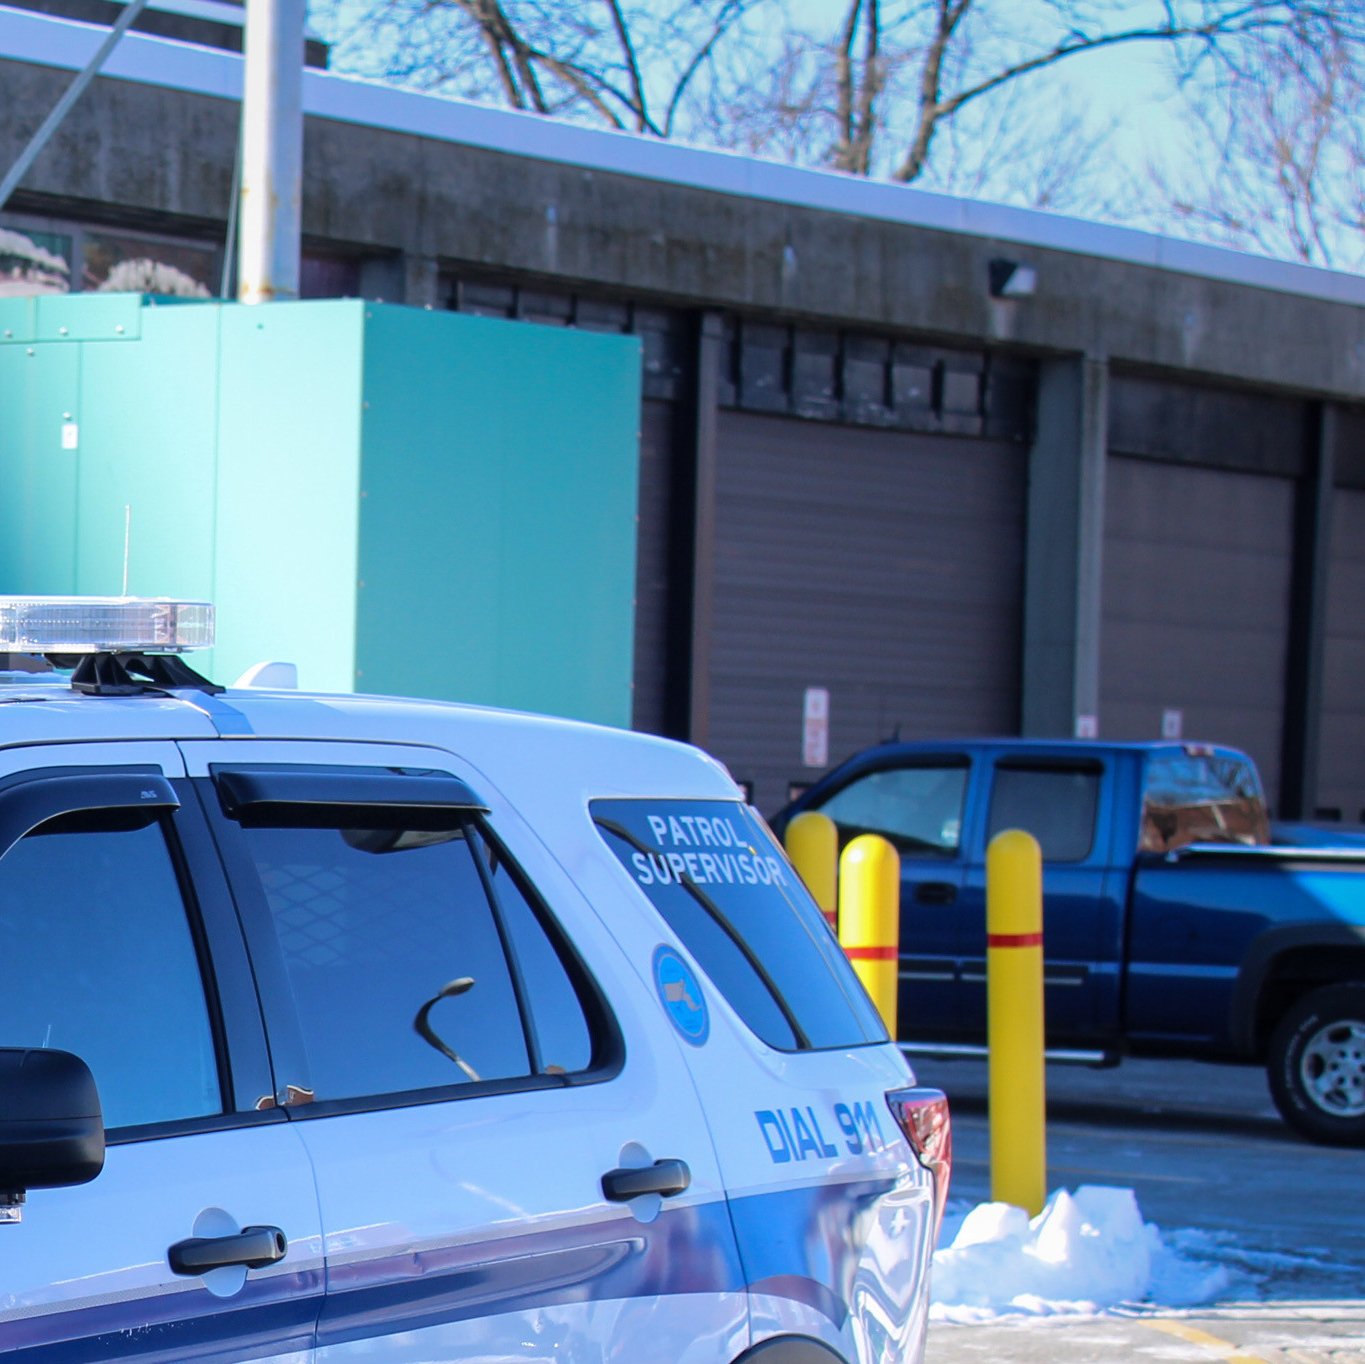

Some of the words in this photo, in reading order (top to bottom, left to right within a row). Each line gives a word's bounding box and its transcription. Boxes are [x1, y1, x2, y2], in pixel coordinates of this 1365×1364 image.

[647, 815, 748, 848] PATROL
[632, 852, 786, 886] SUPERVISOR
[754, 1106, 839, 1164] DIAL
[834, 1101, 886, 1155] 911
